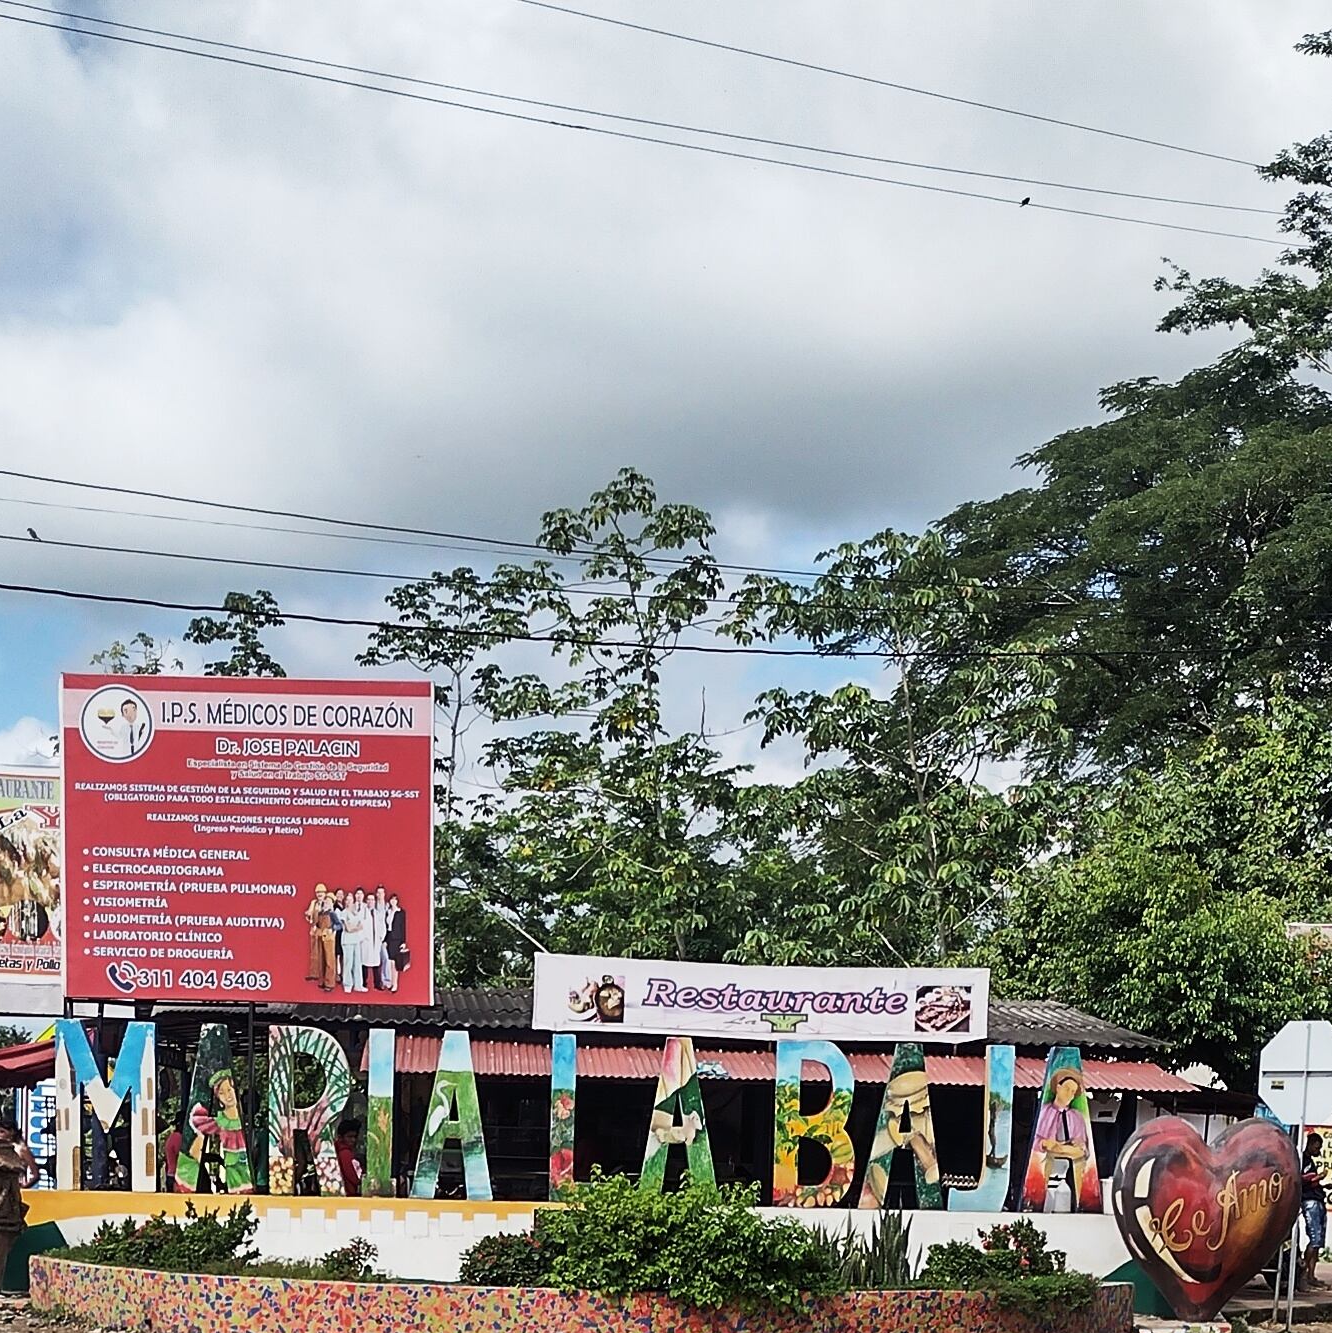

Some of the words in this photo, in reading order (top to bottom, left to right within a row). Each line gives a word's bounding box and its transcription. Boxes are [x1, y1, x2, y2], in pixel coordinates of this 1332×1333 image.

[161, 701, 201, 724] I.P.S.
[206, 698, 287, 726] MÉDICOS
[293, 705, 317, 727] DE
[322, 701, 413, 729] CORAZÓN
[217, 738, 240, 755] Dr.
[244, 740, 280, 756] JOSE
[284, 740, 360, 758] PALACIN
[75, 782, 127, 792] REALIZAMOS
[129, 783, 164, 793] SISTEMA
[167, 785, 178, 793] DE
[180, 783, 216, 794] GESTIÓN
[218, 786, 229, 794] DE
[231, 786, 241, 795] LA
[243, 787, 290, 796] SEGURIDAD
[293, 787, 298, 796] Y
[299, 788, 327, 797] SALUD
[328, 788, 340, 797] EN
[341, 789, 351, 797] EL
[352, 789, 389, 798] TRABAJO
[391, 790, 419, 799] SG-SST
[104, 793, 163, 803] (OBLIGATORIO
[167, 794, 188, 803] PARA
[190, 795, 214, 804] TODO
[215, 796, 291, 806] ESTABLECIMIENTO
[292, 797, 340, 807] COMERCIAL
[341, 799, 348, 807] O
[349, 798, 391, 808] EMPRESA)
[146, 813, 199, 822] REALIZAMOS
[201, 814, 262, 824] EVALUACIONES
[302, 817, 349, 826] LABORALES
[193, 824, 228, 834] (Ingreso
[229, 825, 266, 834] Periódico
[267, 827, 273, 836] y
[275, 826, 303, 836] Retiro)
[92, 846, 150, 858] CONSULTA
[153, 845, 197, 859] MÉDICA
[199, 849, 250, 860] GENERAL
[92, 863, 224, 876] ELECTROCARDIOGRAMA
[92, 880, 176, 893] ESPIROMETRÍA
[179, 882, 227, 894] (PRUEBA
[230, 884, 297, 896] PULMONAR)
[92, 896, 168, 909] VISIOMETRÍA
[92, 913, 172, 926] AUDIOMETRÍA
[175, 914, 223, 927] (PRUEBA
[225, 917, 285, 929] AUDITIVA)
[93, 930, 173, 942] LABORATORIO
[175, 929, 223, 943] CLÍNICO
[92, 946, 147, 958] SERVICIO
[150, 948, 165, 958] DE
[167, 947, 234, 960] DROGUERÍA
[26, 960, 33, 972] y
[137, 969, 173, 987] 311
[179, 969, 218, 988] 404
[221, 971, 272, 990] 5403
[642, 976, 908, 1015] Restaurante
[55, 1018, 493, 1201] MARIA
[772, 1040, 1102, 1214] BAJA
[1207, 1170, 1285, 1251] Amo
